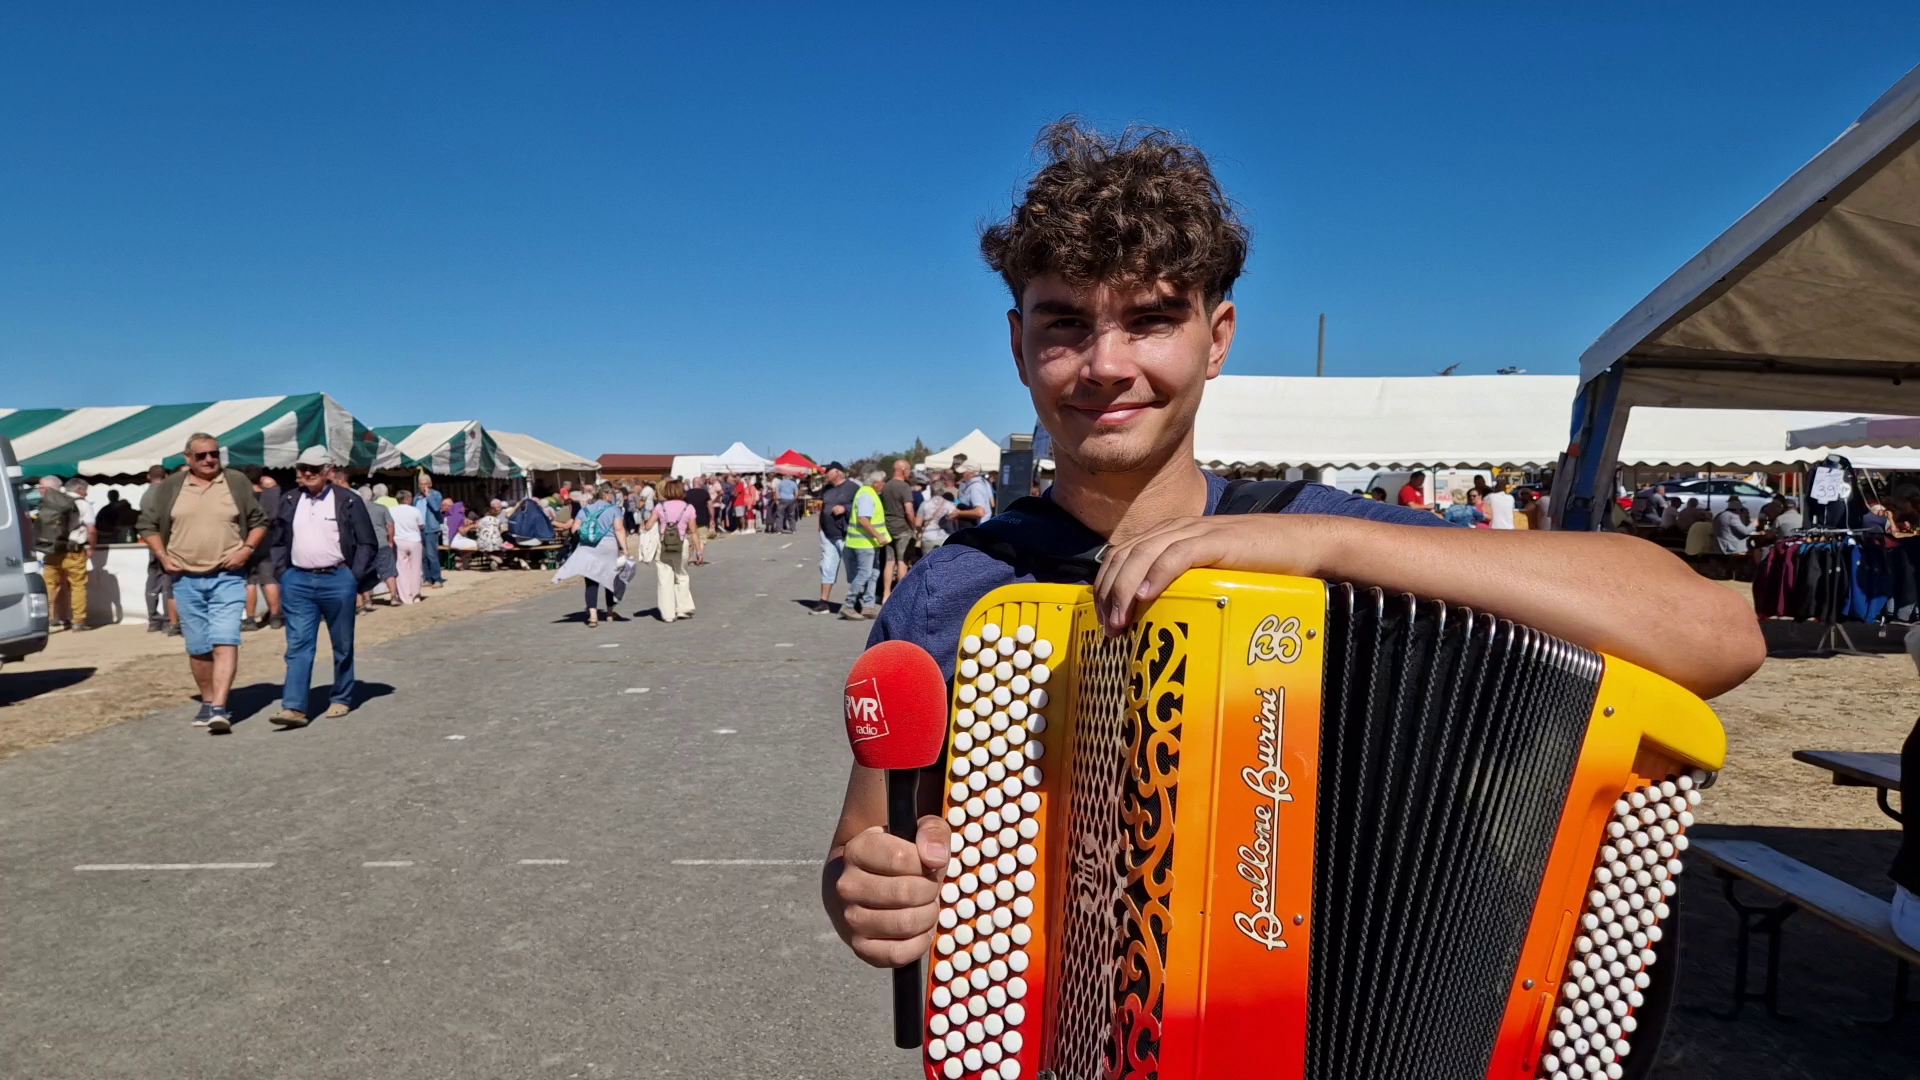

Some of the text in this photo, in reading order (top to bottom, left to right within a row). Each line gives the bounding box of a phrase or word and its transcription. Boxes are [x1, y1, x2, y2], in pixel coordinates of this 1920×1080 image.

[844, 694, 879, 722] RVR
[856, 723, 878, 735] radio
[1233, 685, 1295, 951] Ballone Burini
